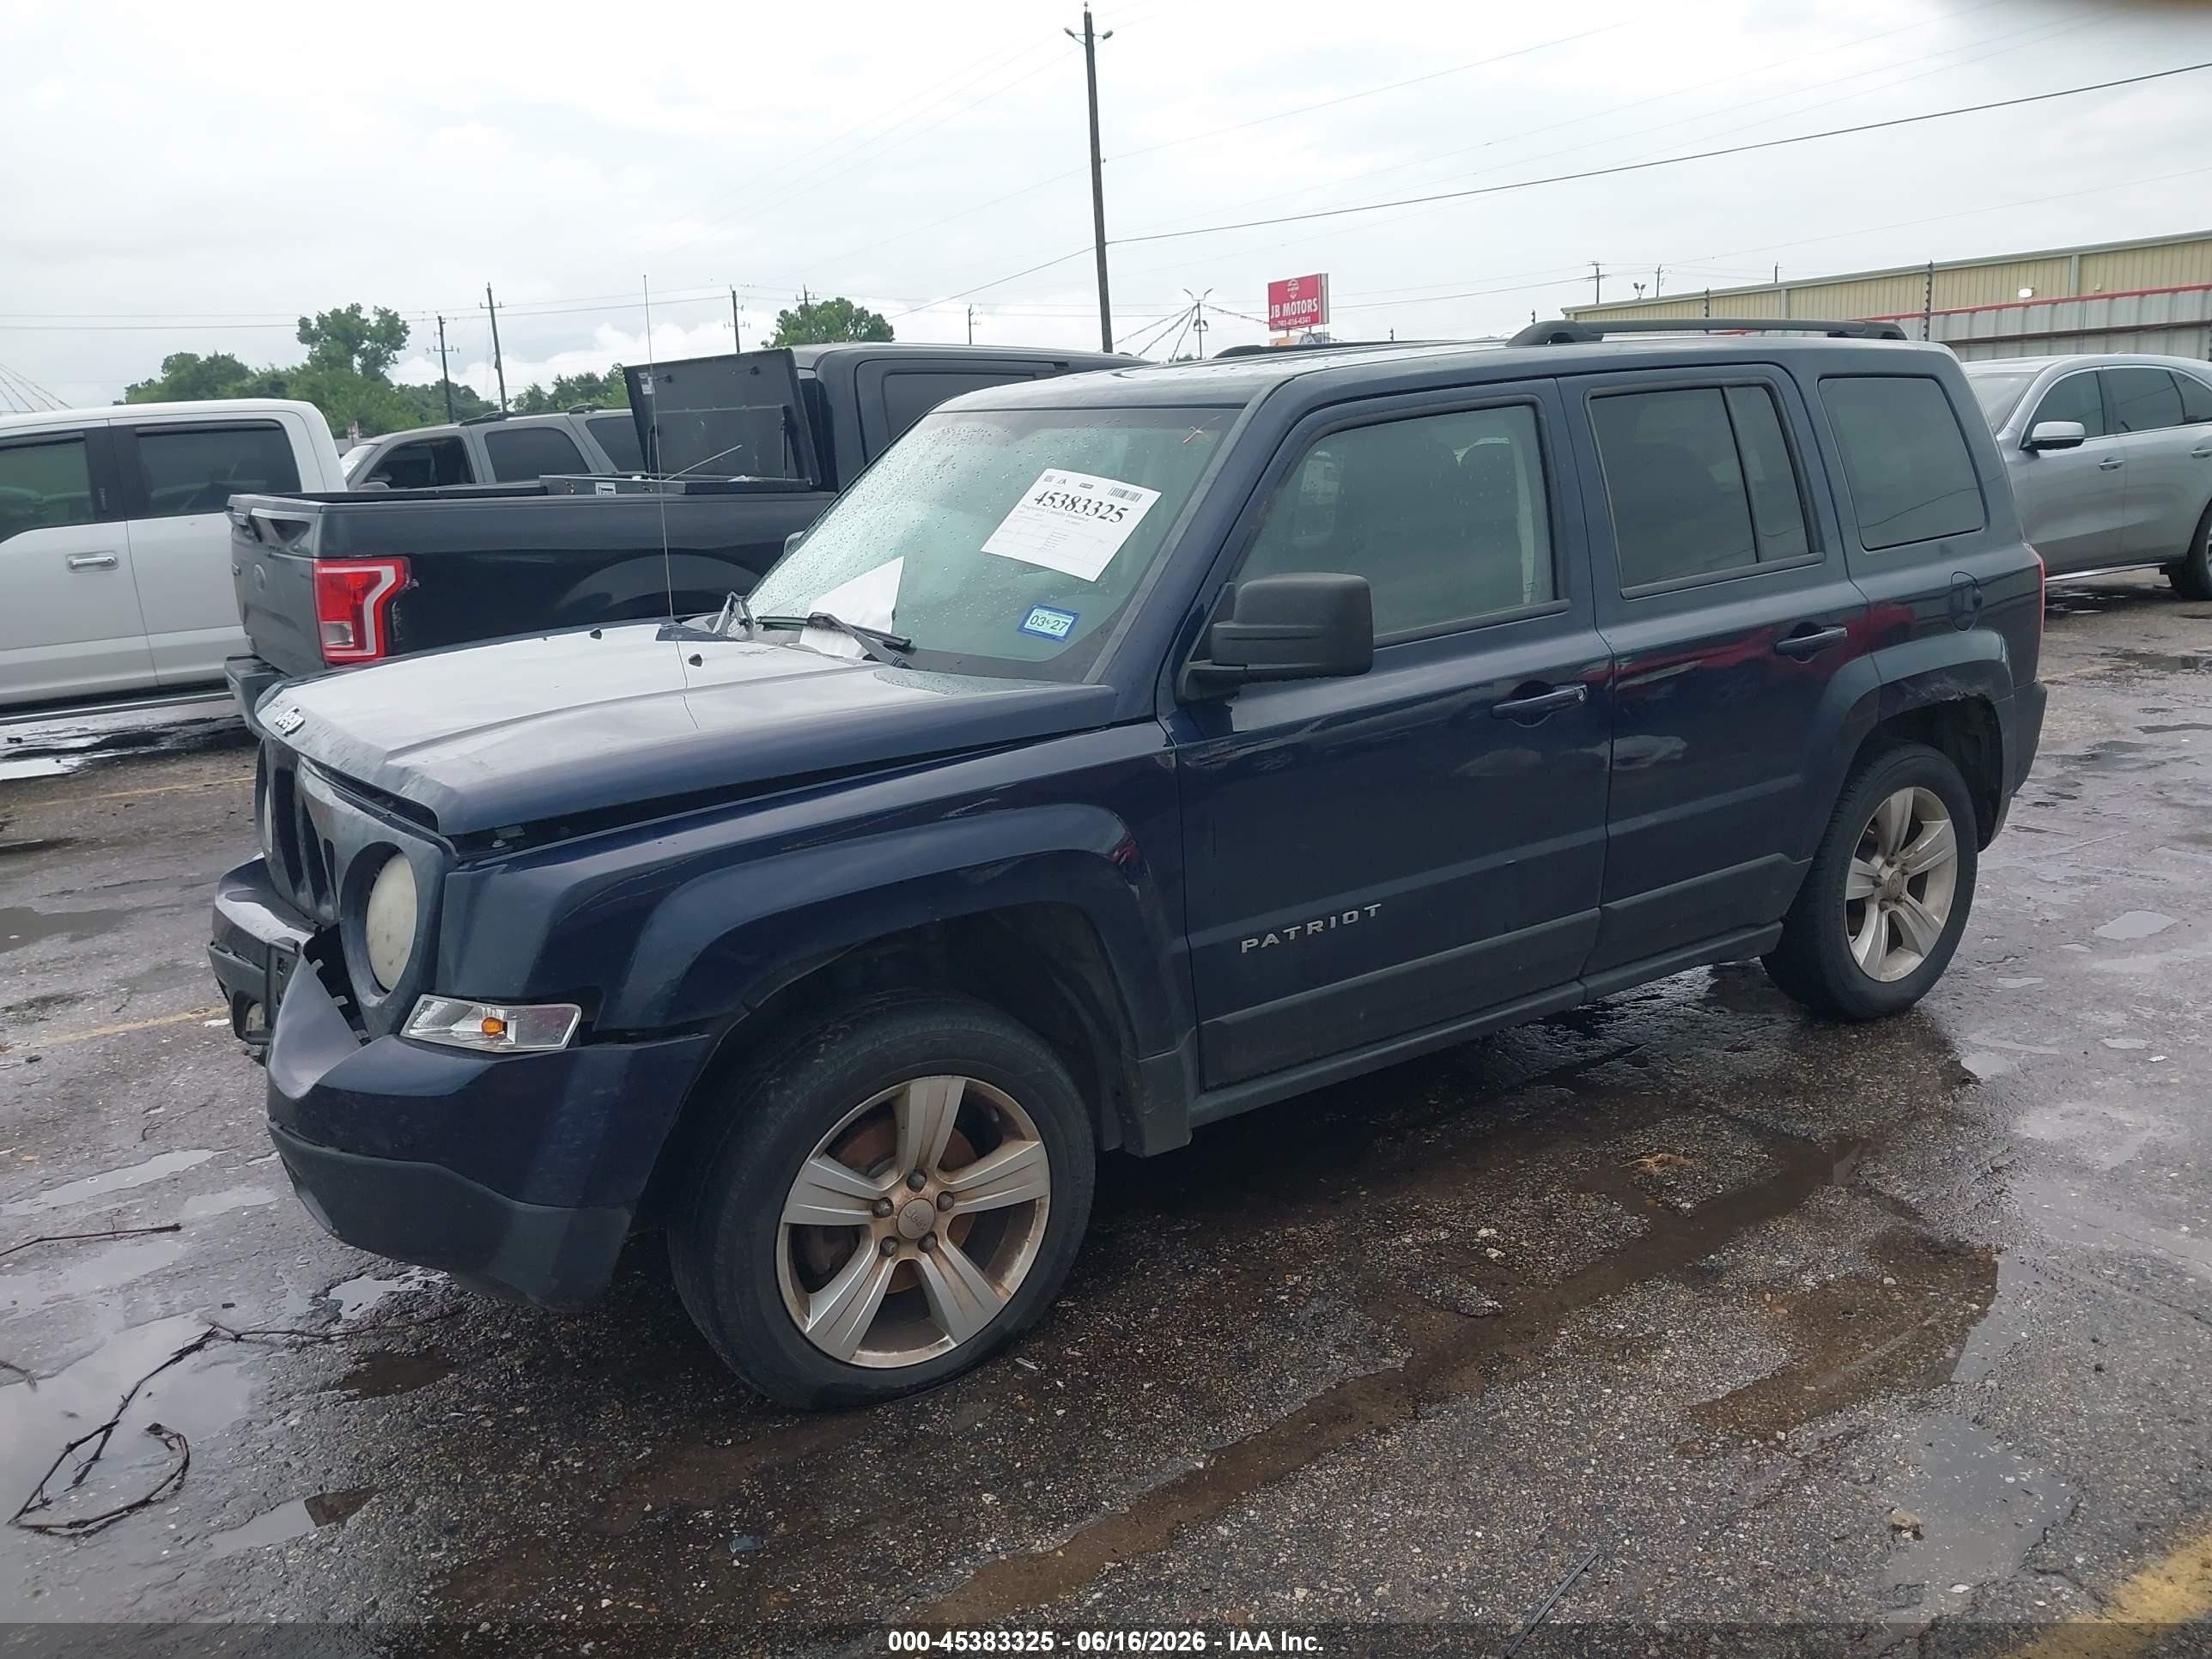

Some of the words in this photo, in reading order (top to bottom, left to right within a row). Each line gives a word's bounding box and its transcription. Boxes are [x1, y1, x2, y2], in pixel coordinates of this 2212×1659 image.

[1271, 305, 1280, 319] JB
[1283, 297, 1318, 317] MOTORS
[1034, 490, 1129, 524] 45383325
[1241, 903, 1382, 954] PATRIOT
